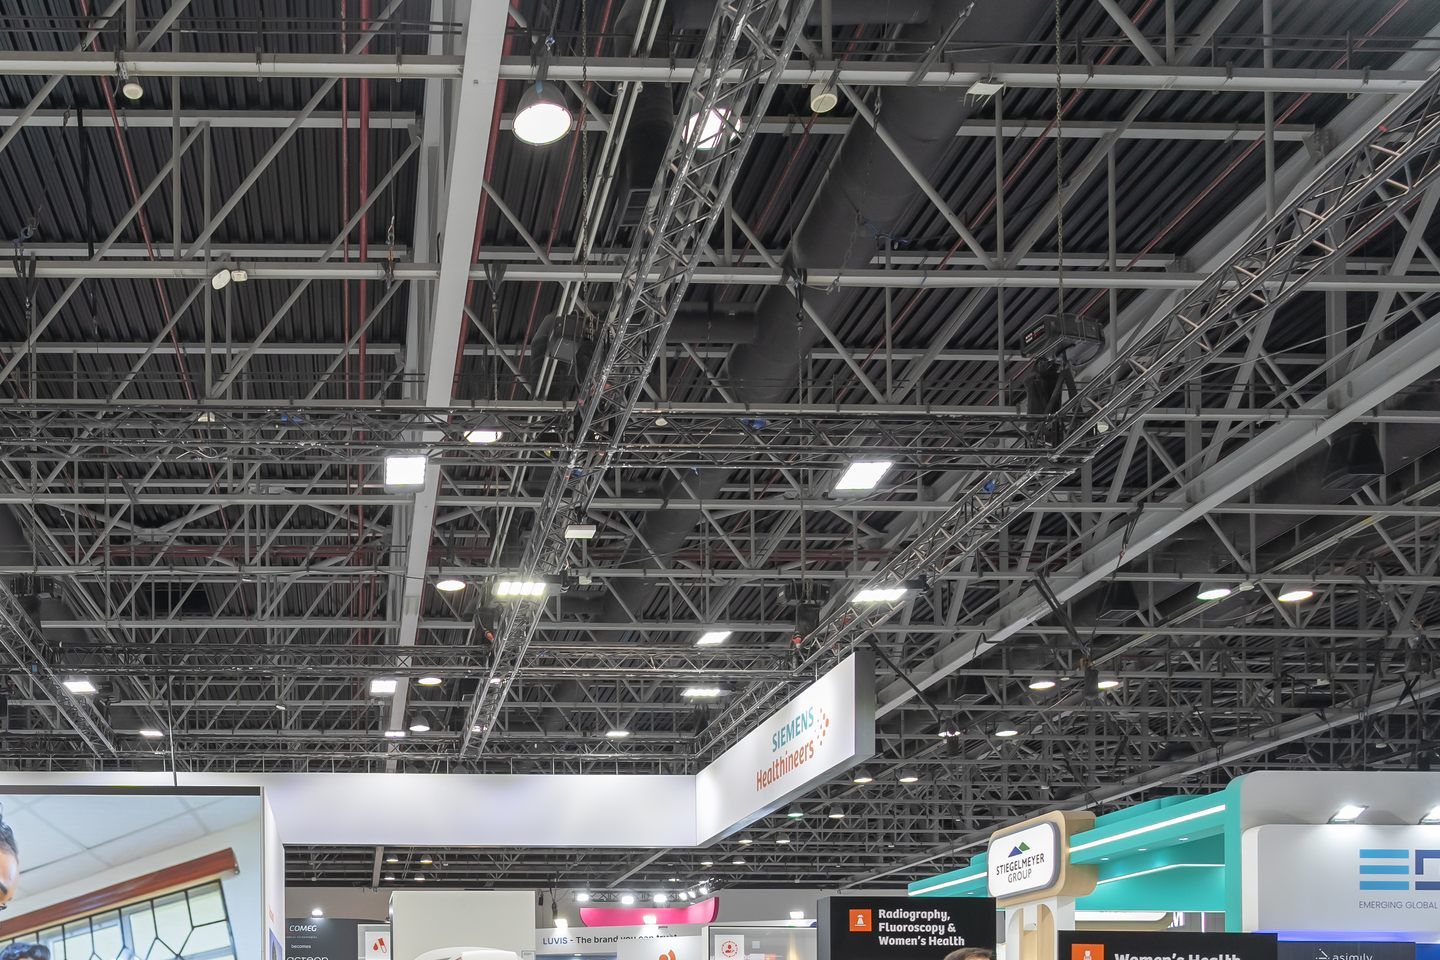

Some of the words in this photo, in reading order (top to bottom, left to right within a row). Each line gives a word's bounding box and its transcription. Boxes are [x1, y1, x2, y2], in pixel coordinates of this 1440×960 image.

[772, 708, 814, 752] SIEMENS
[756, 740, 814, 792] Healthineers
[996, 853, 1045, 876] STIEGELMEYER
[1008, 868, 1032, 883] GROUP
[1359, 900, 1403, 909] EMERGING
[1405, 901, 1438, 909] GLOBAL
[878, 909, 951, 921] Radiography,
[878, 923, 945, 935] Fluoroscopy
[947, 923, 956, 933] &
[542, 937, 568, 945] LUVIS
[878, 936, 927, 946] Women’s
[928, 936, 965, 946] Health
